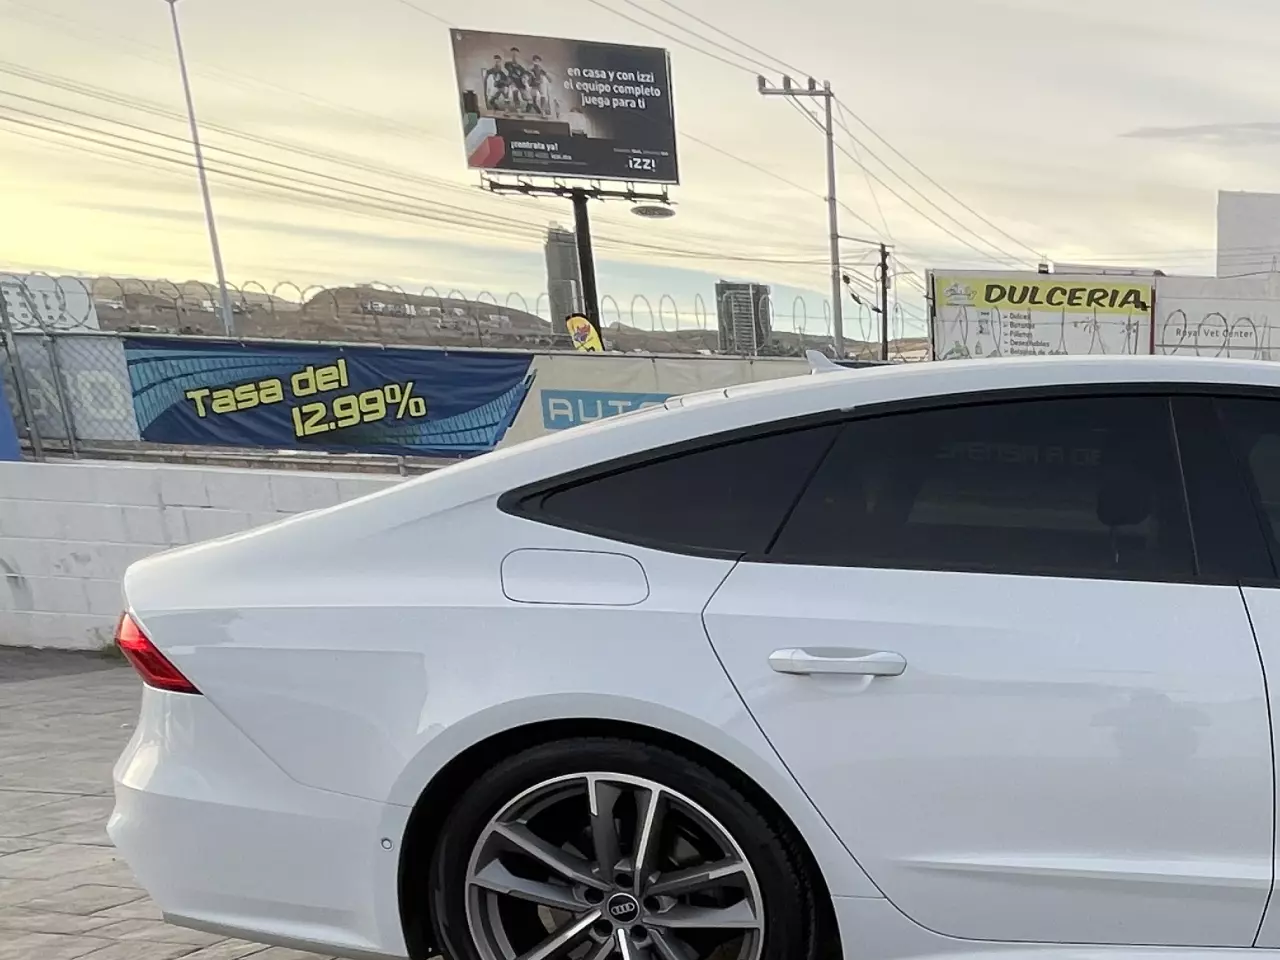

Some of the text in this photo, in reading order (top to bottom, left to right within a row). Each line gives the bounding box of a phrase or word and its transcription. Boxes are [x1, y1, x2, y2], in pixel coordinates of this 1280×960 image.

[567, 67, 655, 83] en casa y con izzi
[563, 79, 661, 97] el equipo completo
[581, 93, 646, 109] juega para ti
[984, 283, 1150, 311] DULCERIA
[1203, 329, 1219, 338] Vet
[186, 358, 349, 418] Tasa del
[291, 382, 427, 437] 12.99%
[549, 397, 664, 422] AUT
